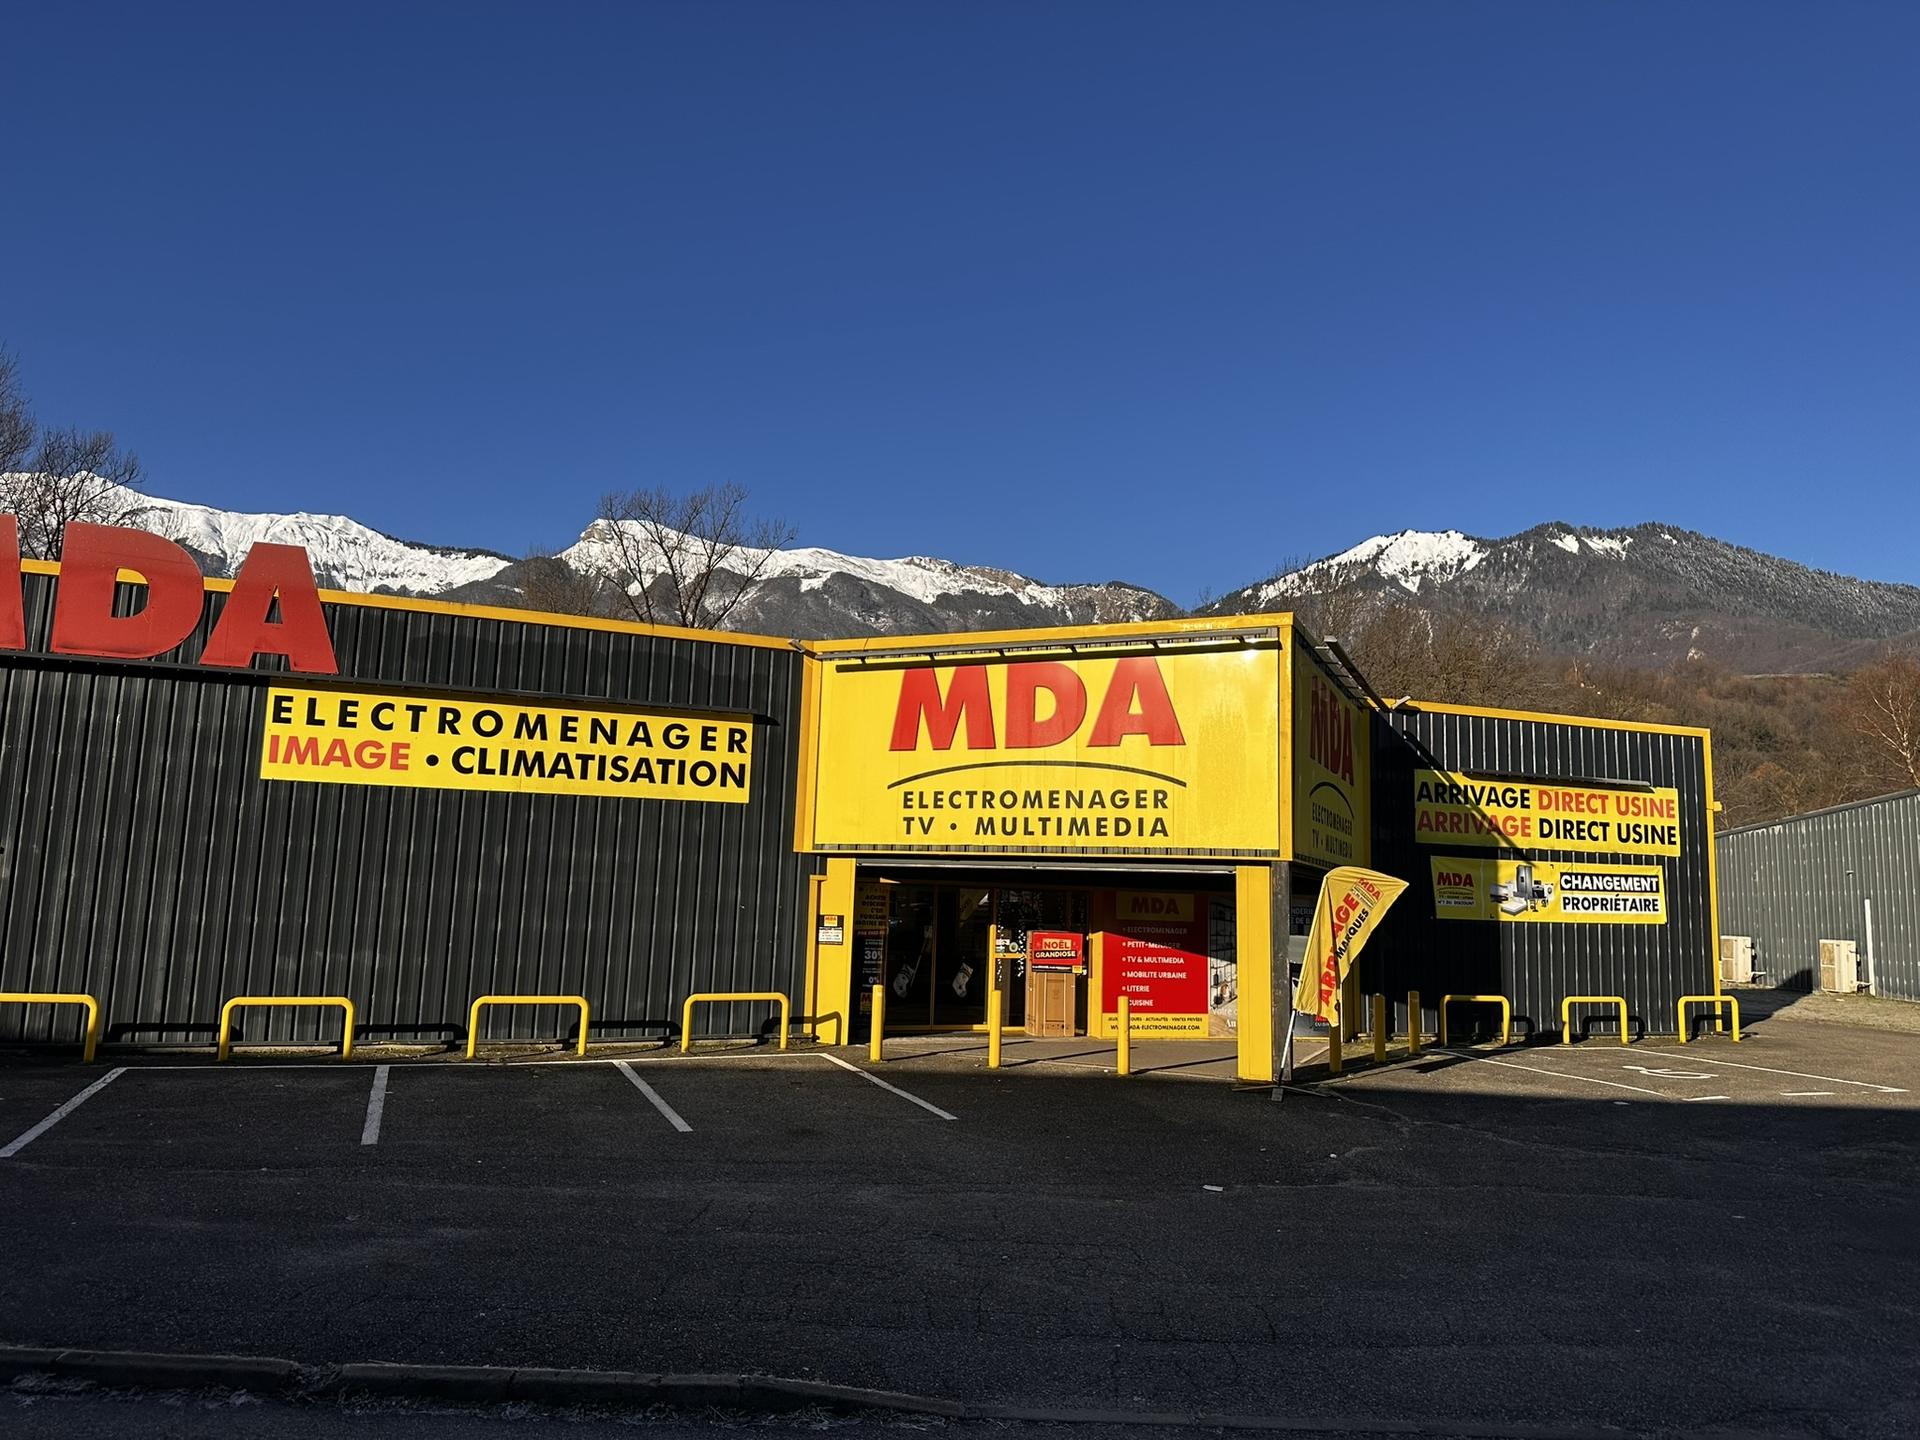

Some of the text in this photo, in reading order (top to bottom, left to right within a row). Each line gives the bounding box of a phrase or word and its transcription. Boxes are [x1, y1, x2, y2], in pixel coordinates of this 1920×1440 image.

[0, 513, 339, 674] DA
[889, 655, 1187, 751] MDA
[272, 695, 748, 754] ELECTROMENAGER
[1310, 675, 1354, 787] MDA
[268, 735, 746, 789] IMAGE CLIMATISATION
[903, 789, 1169, 809] ELECTROMENAGER
[1417, 781, 1675, 818] ARRIVAGE DIRECT USINE
[903, 817, 1169, 837] TV MULTIMEDIA
[1312, 802, 1352, 836] ELECTROMENAGER
[1417, 810, 1677, 845] ARRIVAGE DIRECT USINE
[1312, 828, 1352, 858] TV MULTIMEDIA
[1437, 872, 1474, 887] MDA
[1560, 875, 1658, 892] CHANGEMENT
[1131, 896, 1180, 914] MDA
[1562, 894, 1659, 912] PROPRIÉTAIRE
[1127, 926, 1188, 935] ELECTROMENAGER
[1336, 908, 1370, 960] MARQUES
[1035, 950, 1076, 959] GRANDIOSE
[1127, 955, 1136, 963] TV
[1143, 956, 1184, 964] MULTIMEDIA
[1318, 893, 1359, 1006] ARRAGE
[1127, 971, 1157, 979] MOBILITE
[1127, 984, 1150, 992] LITERIE
